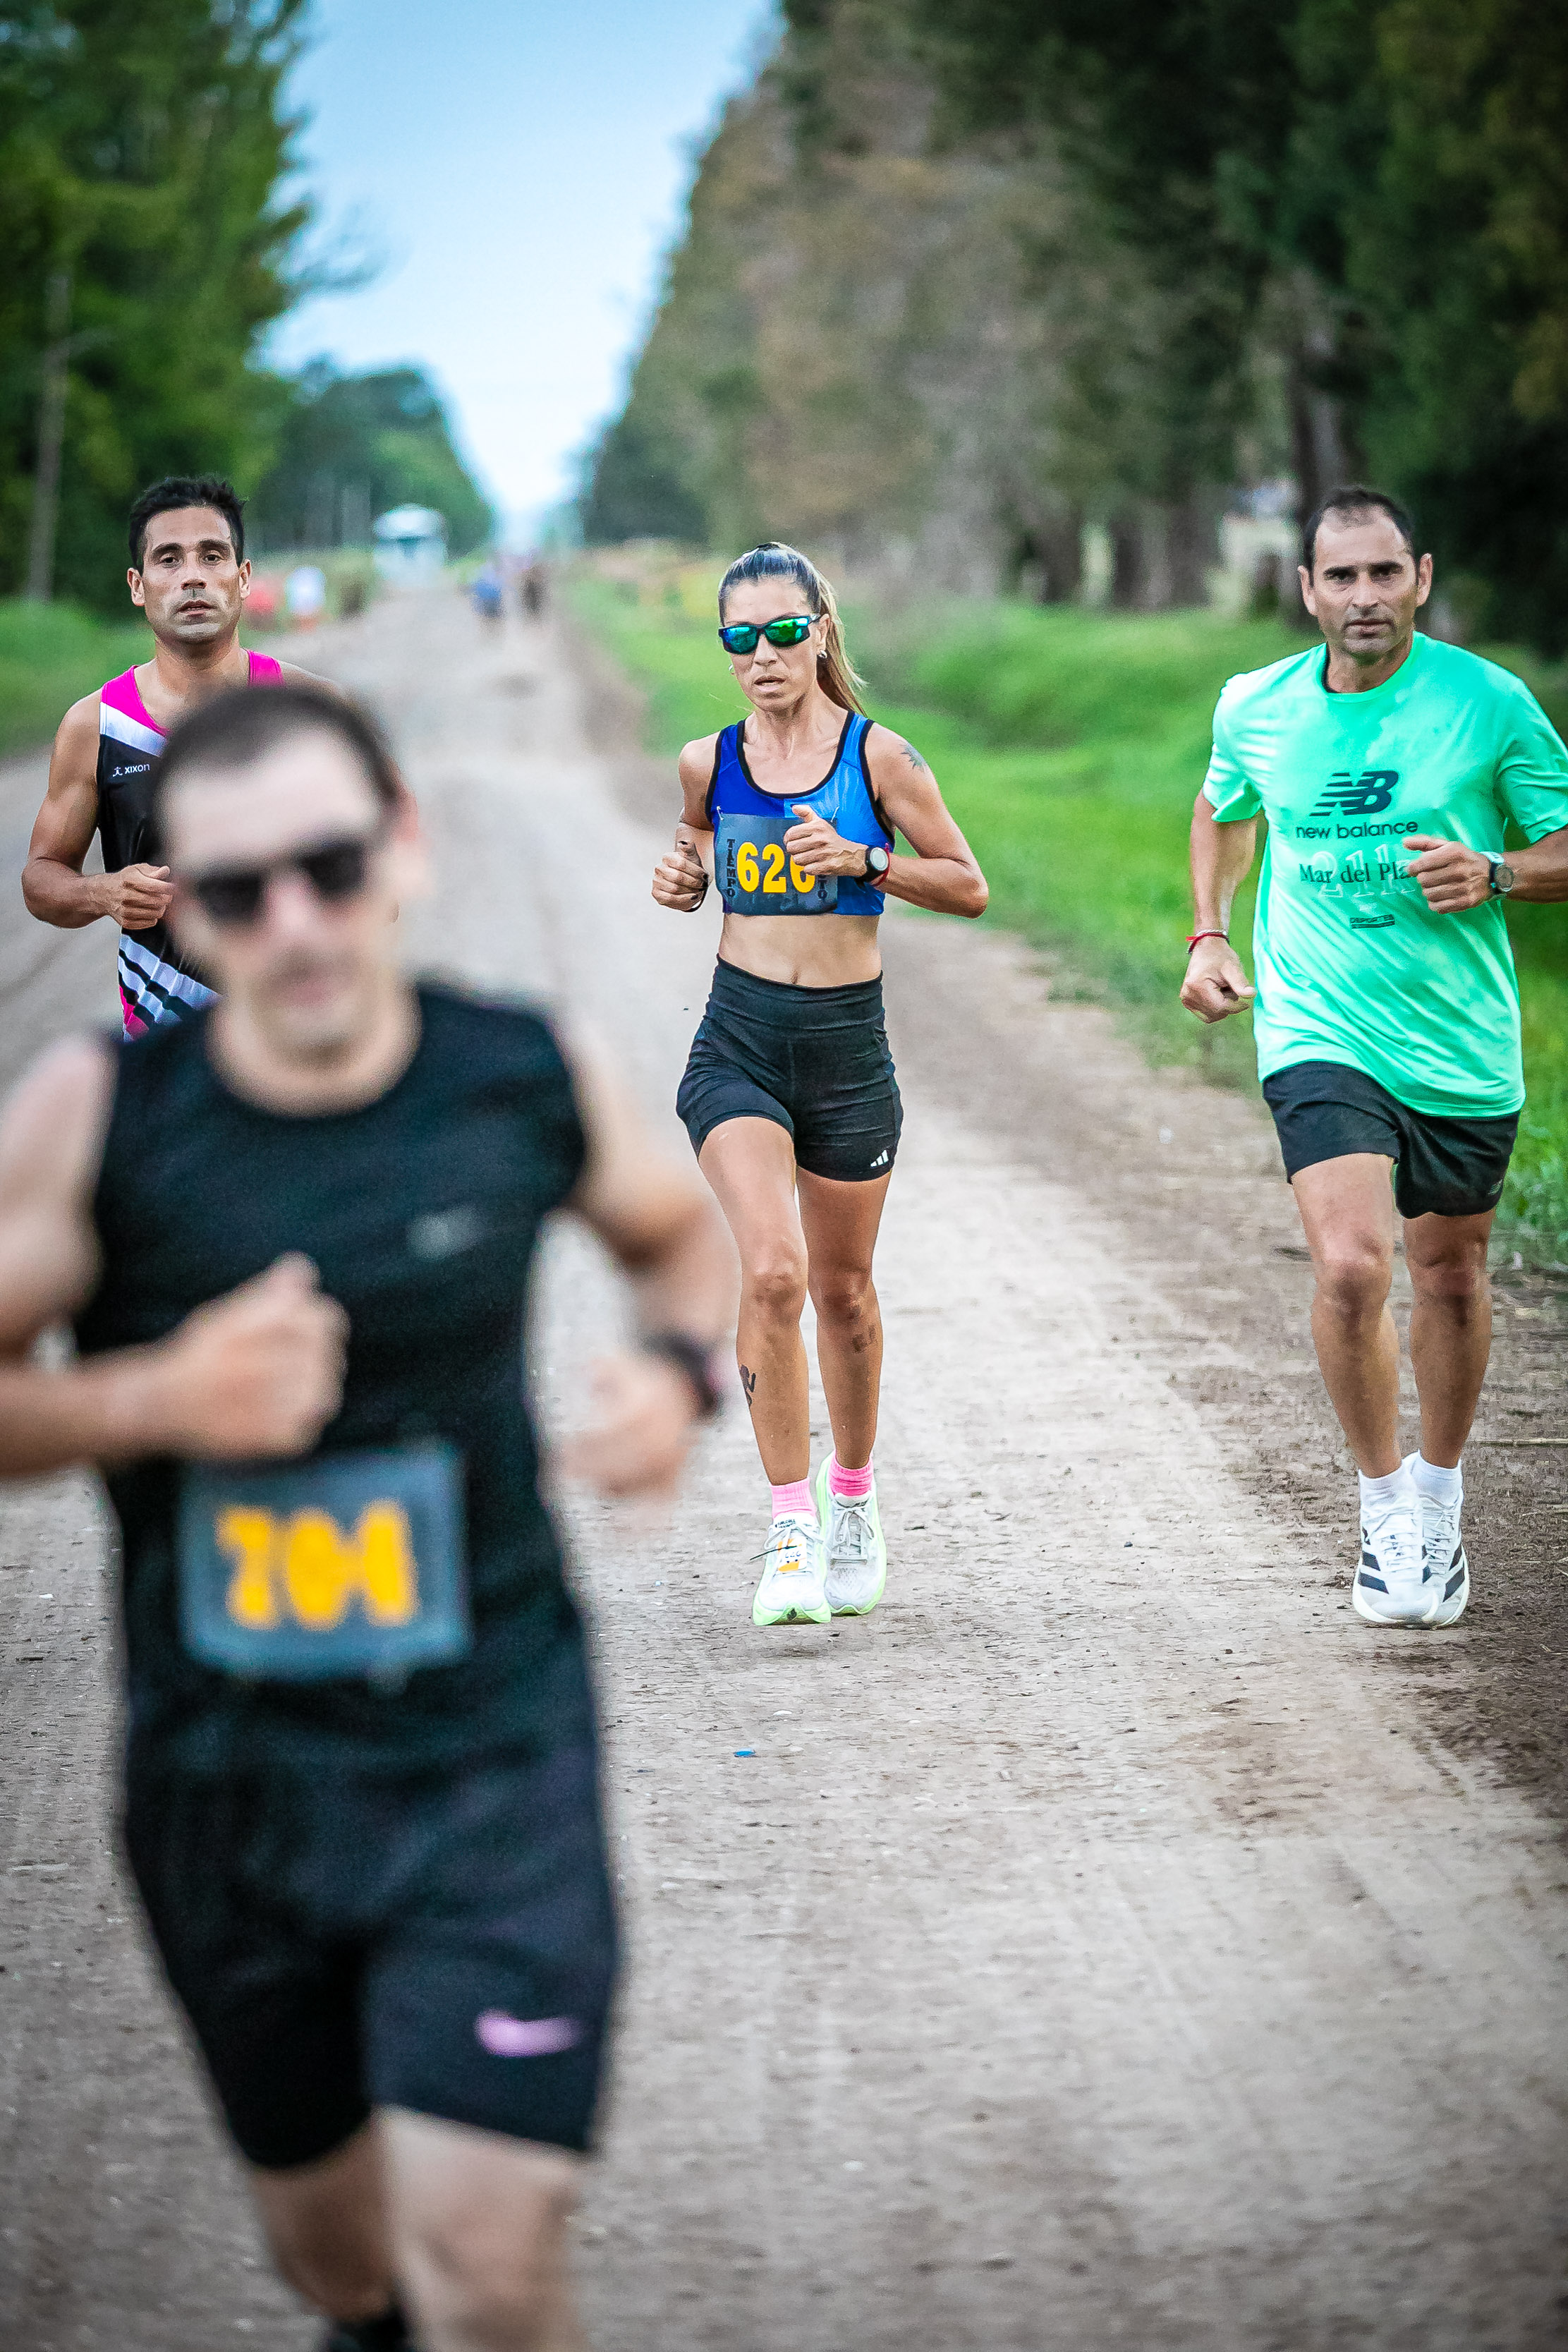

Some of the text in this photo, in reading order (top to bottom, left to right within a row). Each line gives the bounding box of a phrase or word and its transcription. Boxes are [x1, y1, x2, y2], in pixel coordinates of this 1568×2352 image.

[1296, 820, 1418, 839] new balance
[1299, 861, 1414, 883] Mar del Pla
